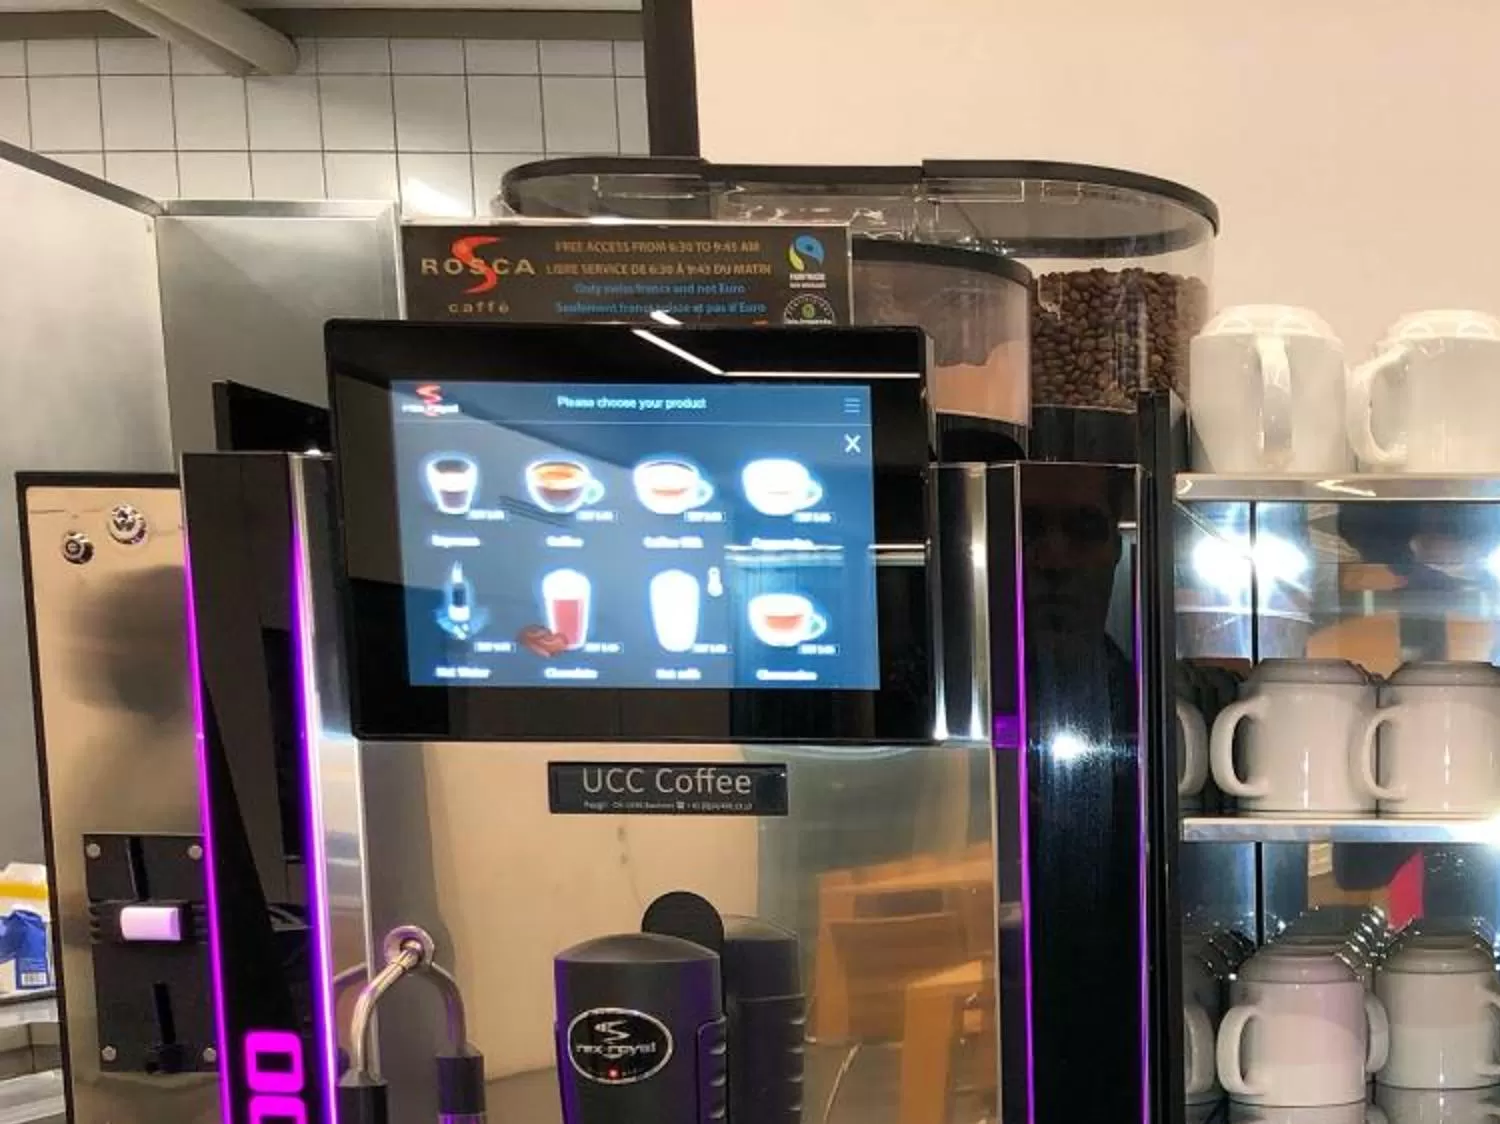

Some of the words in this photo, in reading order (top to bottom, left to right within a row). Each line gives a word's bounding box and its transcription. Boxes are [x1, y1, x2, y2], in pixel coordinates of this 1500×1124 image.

[631, 241, 667, 253] FROM
[695, 241, 711, 253] TO
[581, 263, 629, 275] SERVICE
[733, 263, 771, 275] MATIN
[557, 396, 594, 409] Please
[597, 396, 637, 410] choose
[639, 399, 663, 411] your
[665, 397, 708, 411] product
[582, 767, 645, 794] UCC
[655, 767, 752, 794] Coffee
